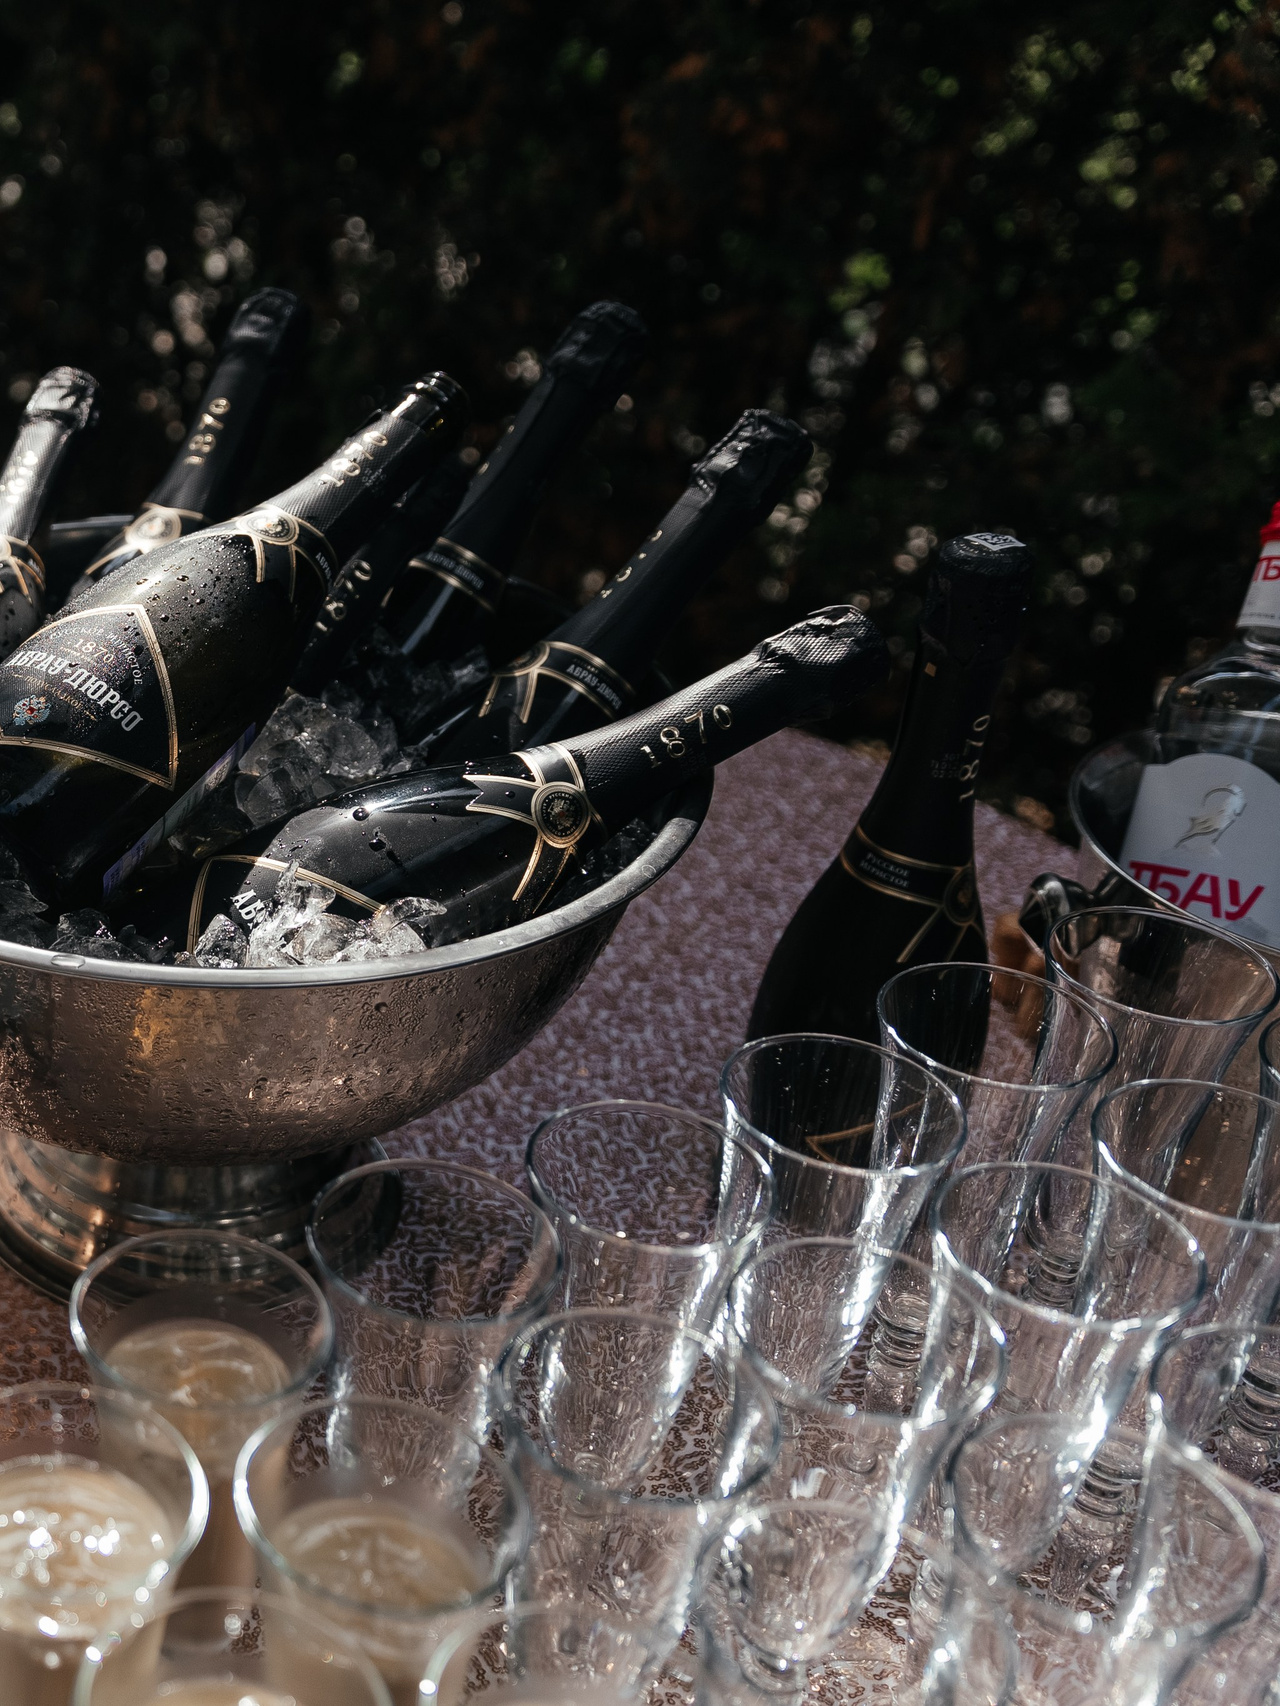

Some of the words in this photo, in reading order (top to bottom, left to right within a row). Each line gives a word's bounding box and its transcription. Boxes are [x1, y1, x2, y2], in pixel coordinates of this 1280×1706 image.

[73, 638, 114, 663] 1870
[6, 650, 144, 732] АБРАУ-ДЮРСО
[640, 703, 732, 769] 1870
[865, 851, 910, 878] РУССКОЕ
